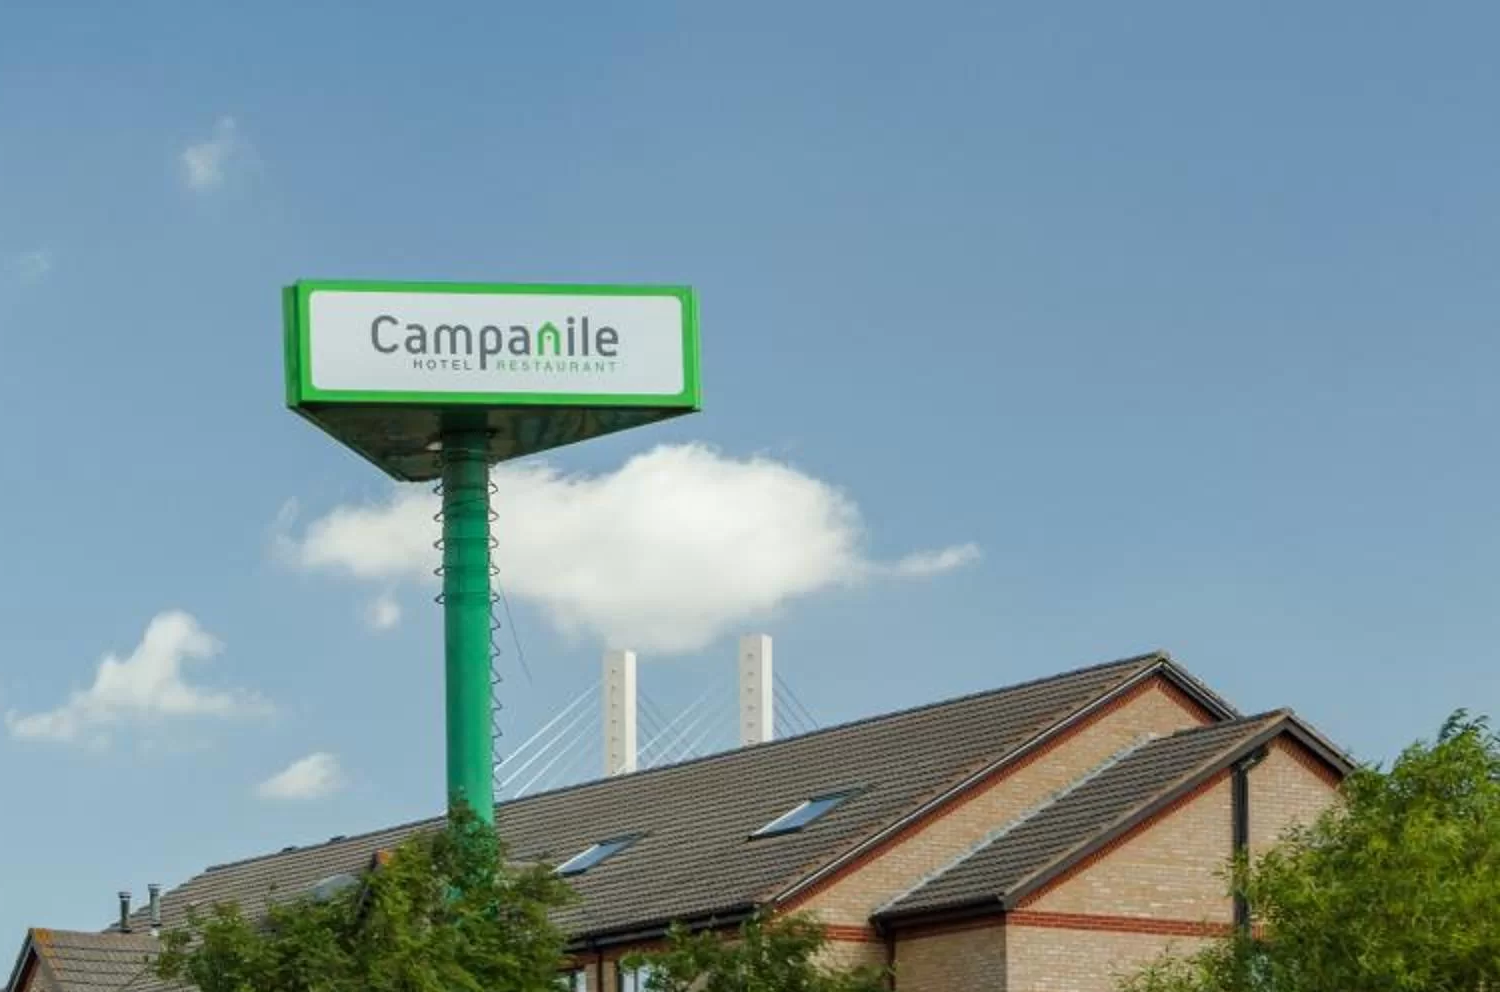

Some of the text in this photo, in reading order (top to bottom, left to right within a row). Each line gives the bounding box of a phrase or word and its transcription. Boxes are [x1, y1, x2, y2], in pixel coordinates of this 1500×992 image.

[370, 314, 619, 370] Campanile
[413, 359, 617, 373] HOTEL RESTAURANT
